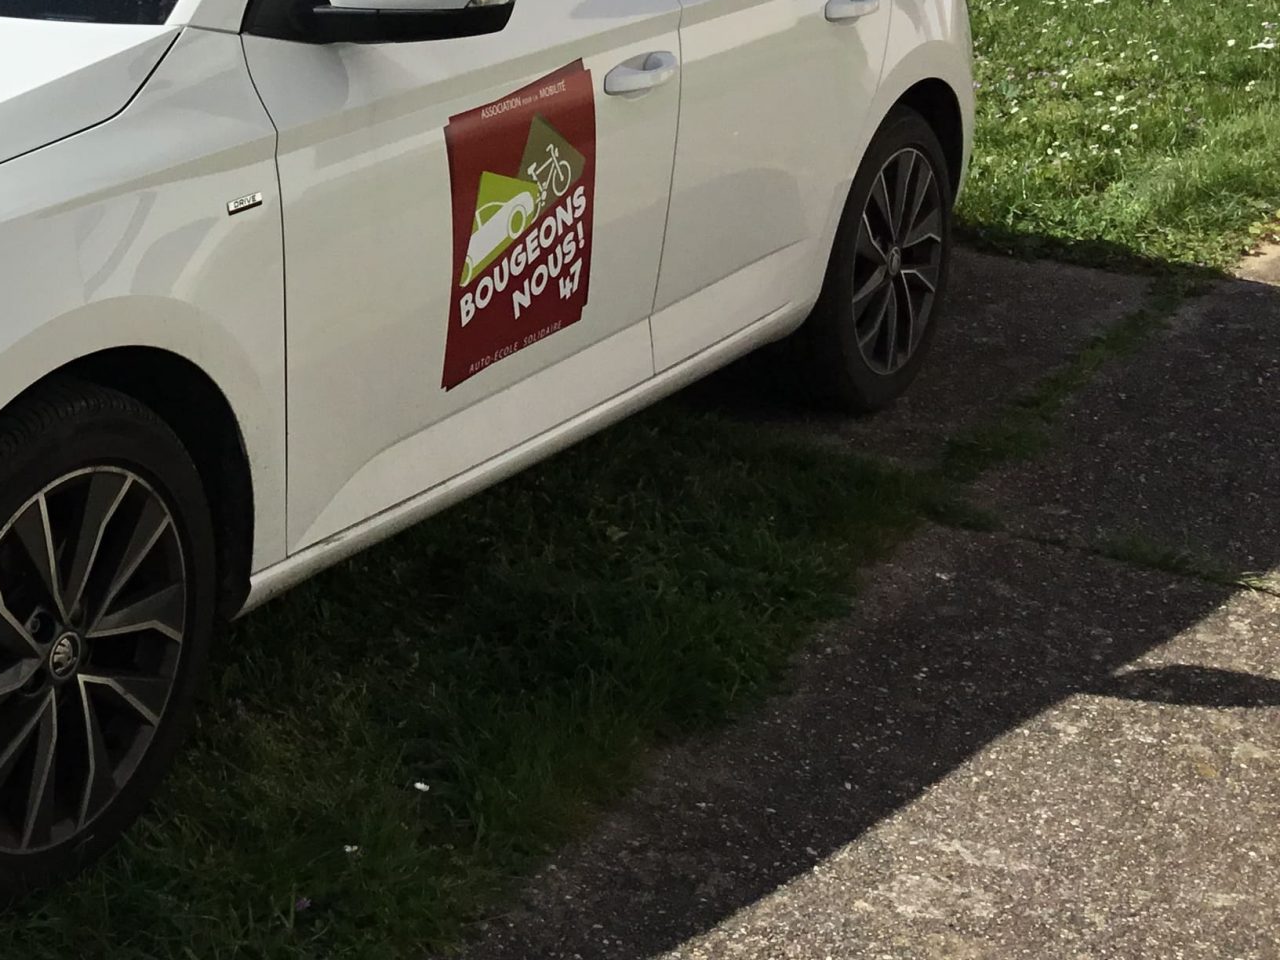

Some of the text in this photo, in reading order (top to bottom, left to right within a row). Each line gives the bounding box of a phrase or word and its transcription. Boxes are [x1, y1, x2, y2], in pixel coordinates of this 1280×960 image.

[481, 96, 522, 120] ASSOCIATION
[460, 186, 587, 328] BOUGEONS
[558, 257, 583, 300] 47
[523, 319, 562, 346] SOLIDAIRE
